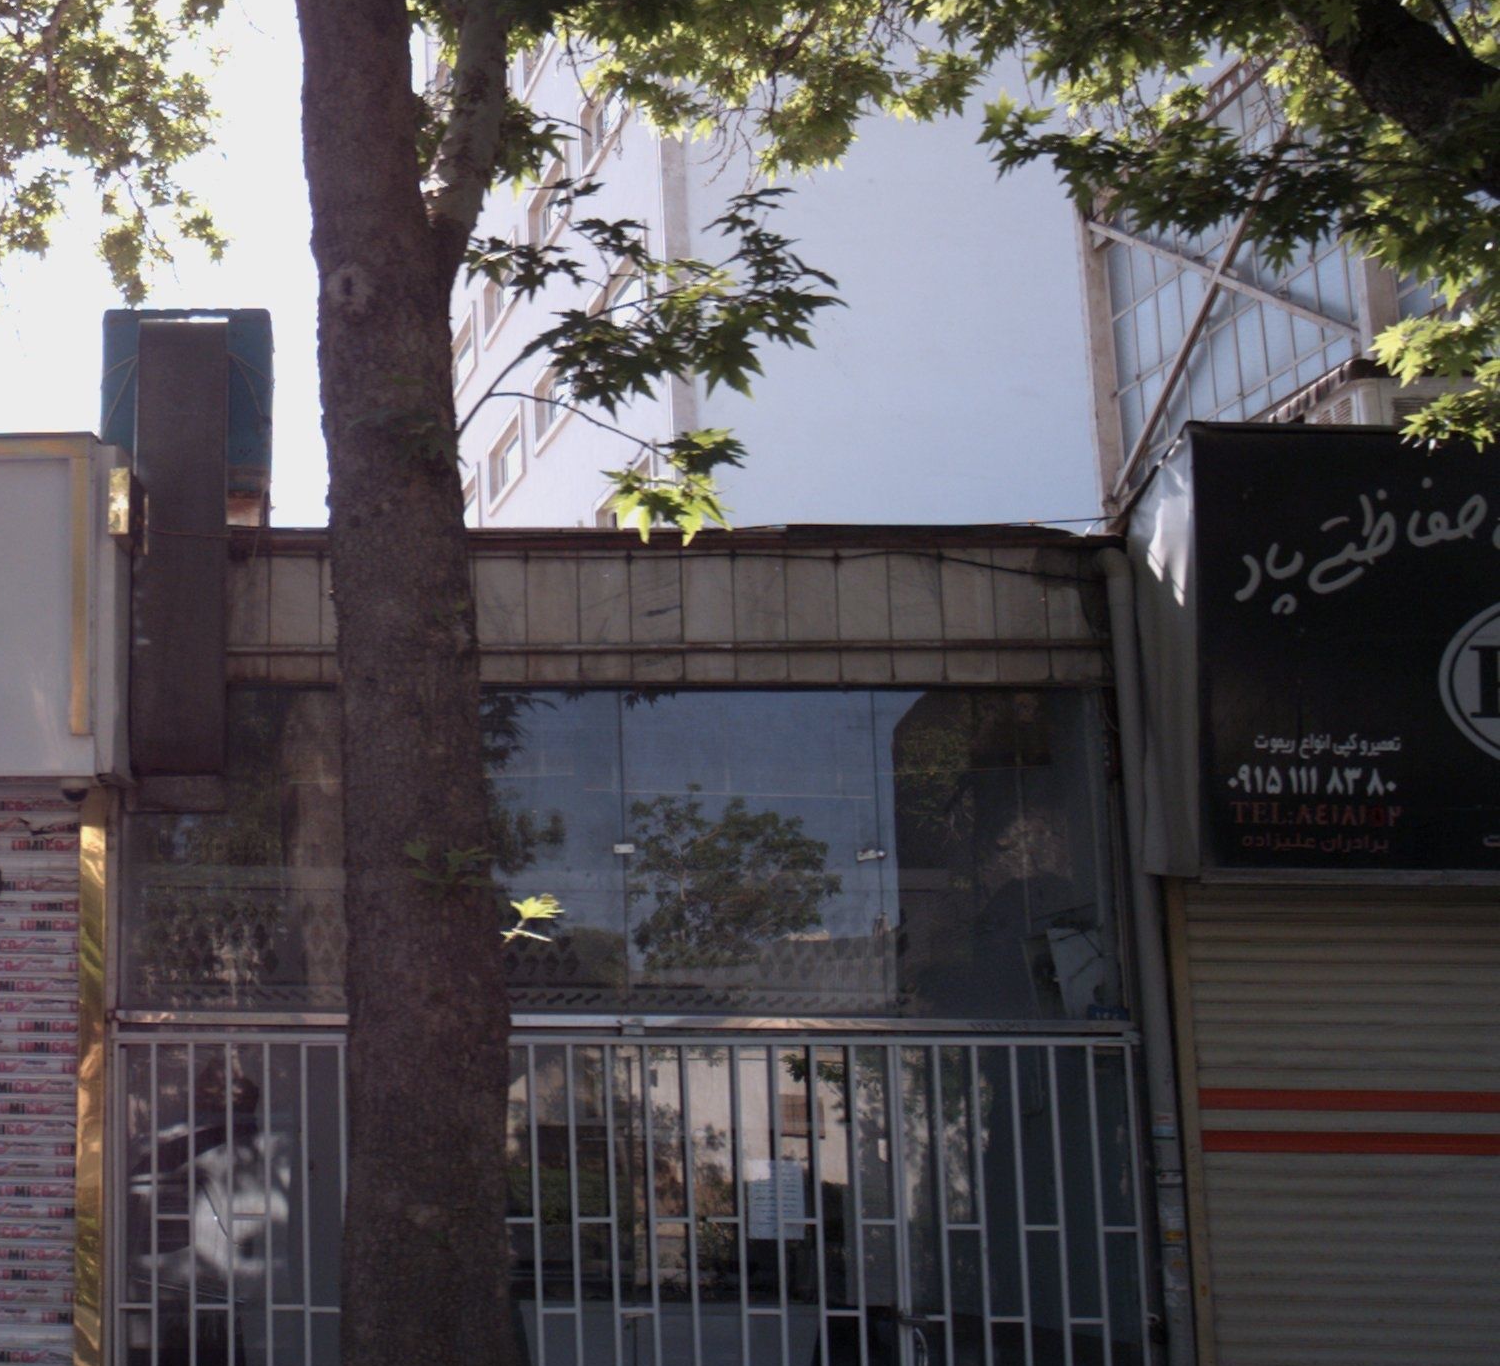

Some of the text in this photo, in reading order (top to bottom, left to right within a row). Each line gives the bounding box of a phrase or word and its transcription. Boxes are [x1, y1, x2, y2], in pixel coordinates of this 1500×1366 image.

[1254, 734, 1296, 754] ریموت
[1299, 733, 1331, 759] انواع
[1228, 764, 1282, 794] ۰۹۱۵
[1289, 765, 1318, 795] ۱۱۱
